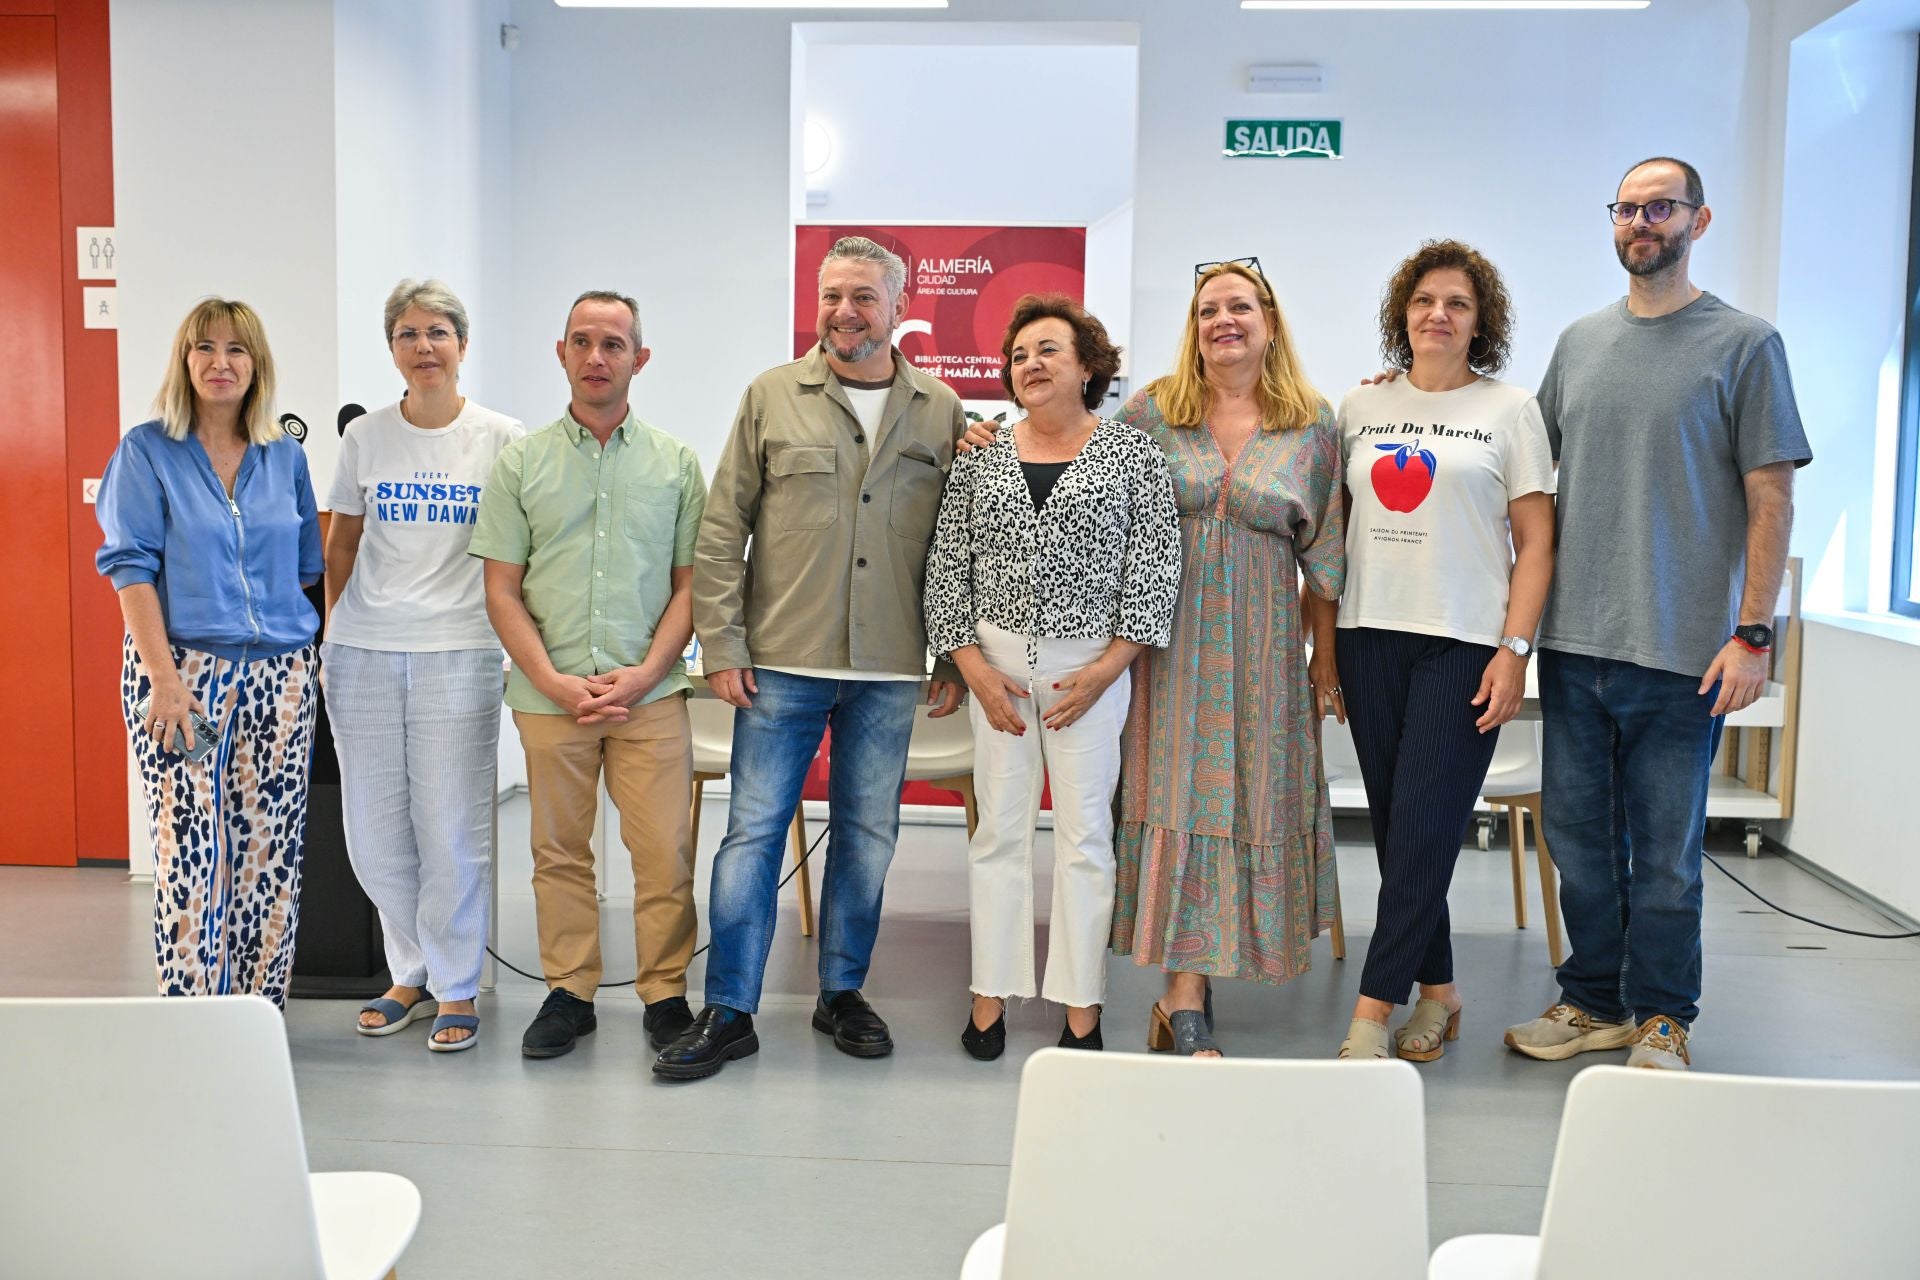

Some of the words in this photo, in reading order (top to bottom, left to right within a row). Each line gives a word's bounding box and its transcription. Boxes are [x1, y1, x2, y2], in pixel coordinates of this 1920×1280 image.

[1234, 126, 1332, 152] SALIDA
[917, 256, 993, 274] ALMERÍA
[917, 275, 956, 285] CIUDAD
[917, 287, 935, 295] ÁREA
[914, 355, 963, 364] BIBLIOTECA
[964, 356, 1002, 364] CENTRAL
[916, 365, 942, 378] OSÉ
[944, 365, 981, 378] MARÍA
[1359, 423, 1396, 436] Fruit
[1400, 422, 1424, 435] Du
[1430, 423, 1493, 444] Marché
[414, 471, 449, 479] EVERY
[376, 482, 482, 504] SUNSET
[377, 503, 418, 522] NEW
[427, 504, 479, 525] DAWN
